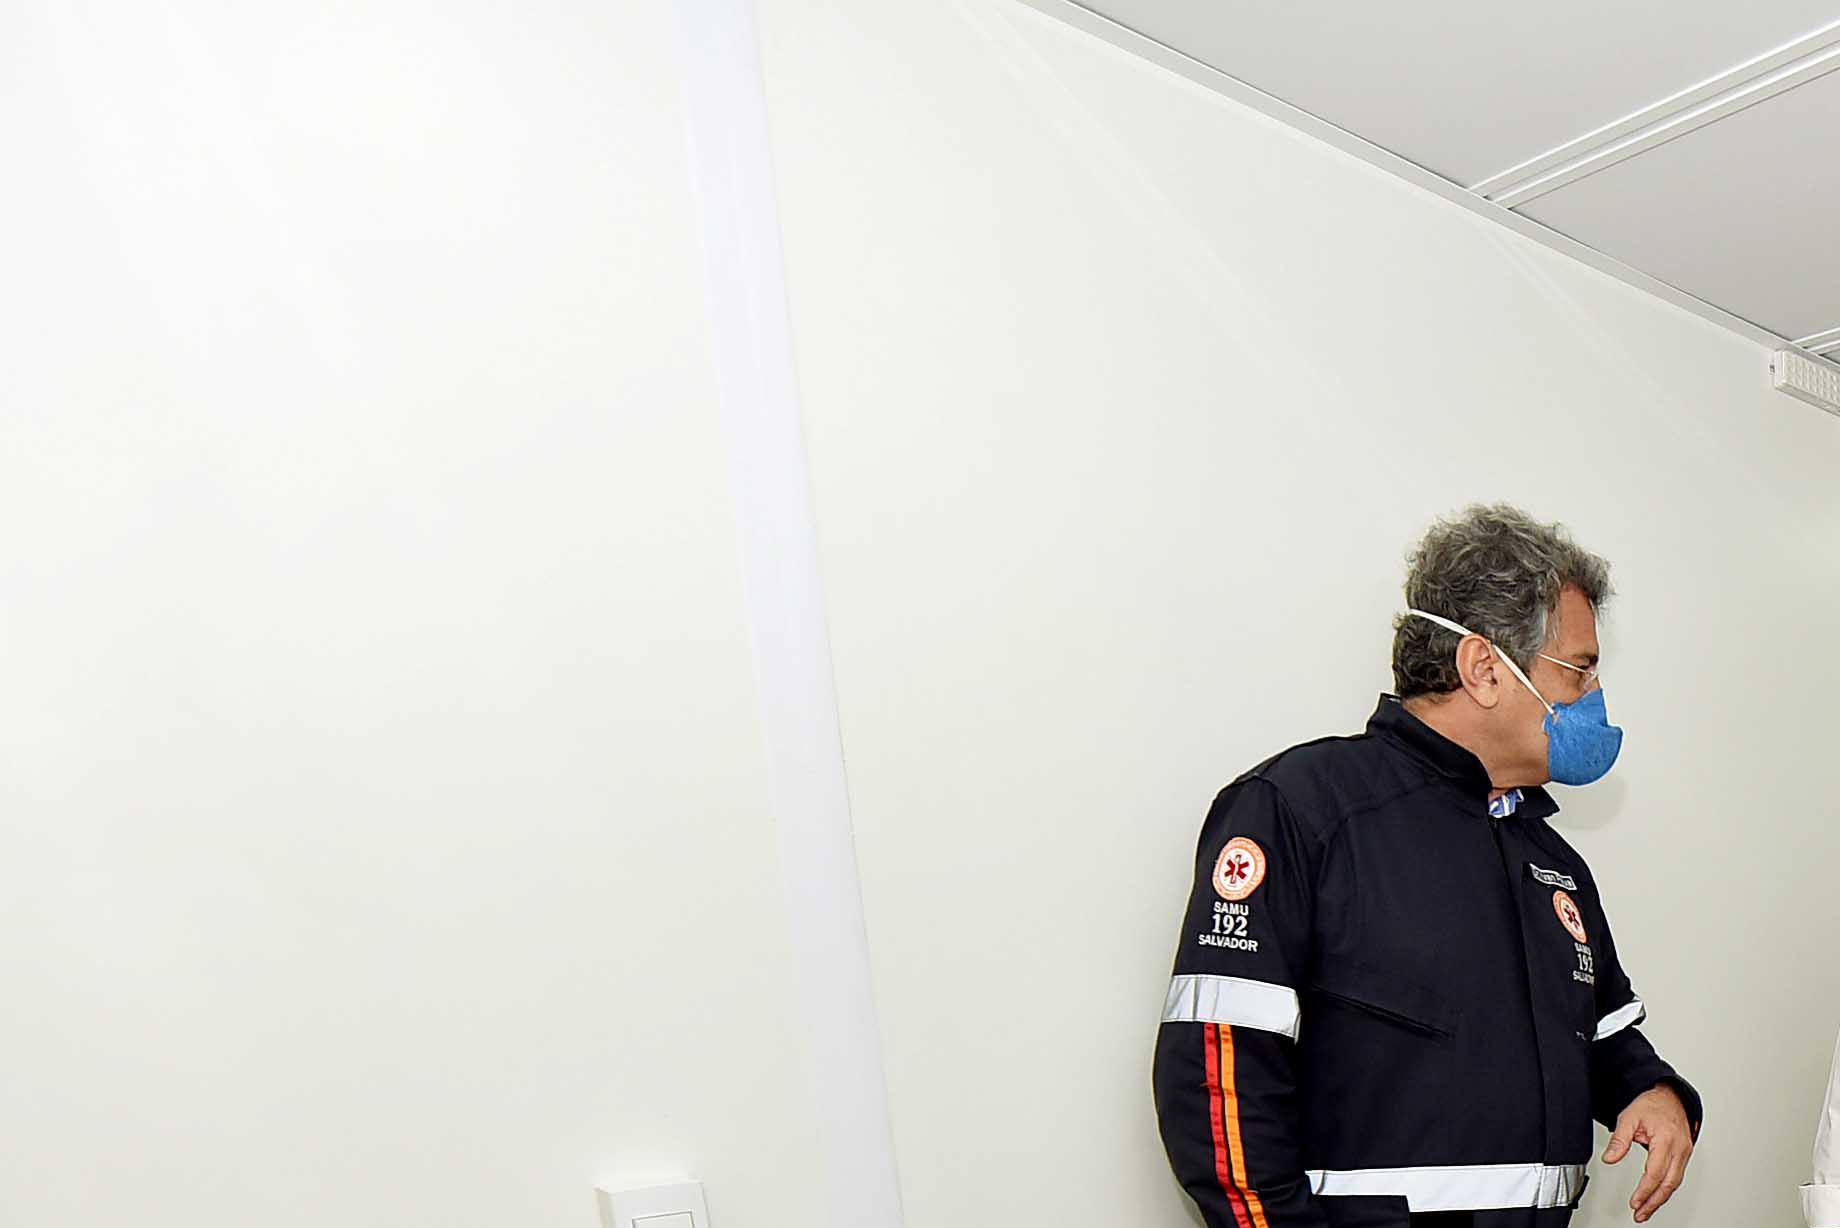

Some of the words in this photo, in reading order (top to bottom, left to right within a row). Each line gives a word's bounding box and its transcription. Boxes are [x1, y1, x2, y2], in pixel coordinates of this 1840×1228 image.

[1213, 901, 1250, 916] SAMU
[1212, 913, 1248, 937] 192
[1198, 934, 1258, 953] SALVADOR
[1577, 953, 1594, 973] 192
